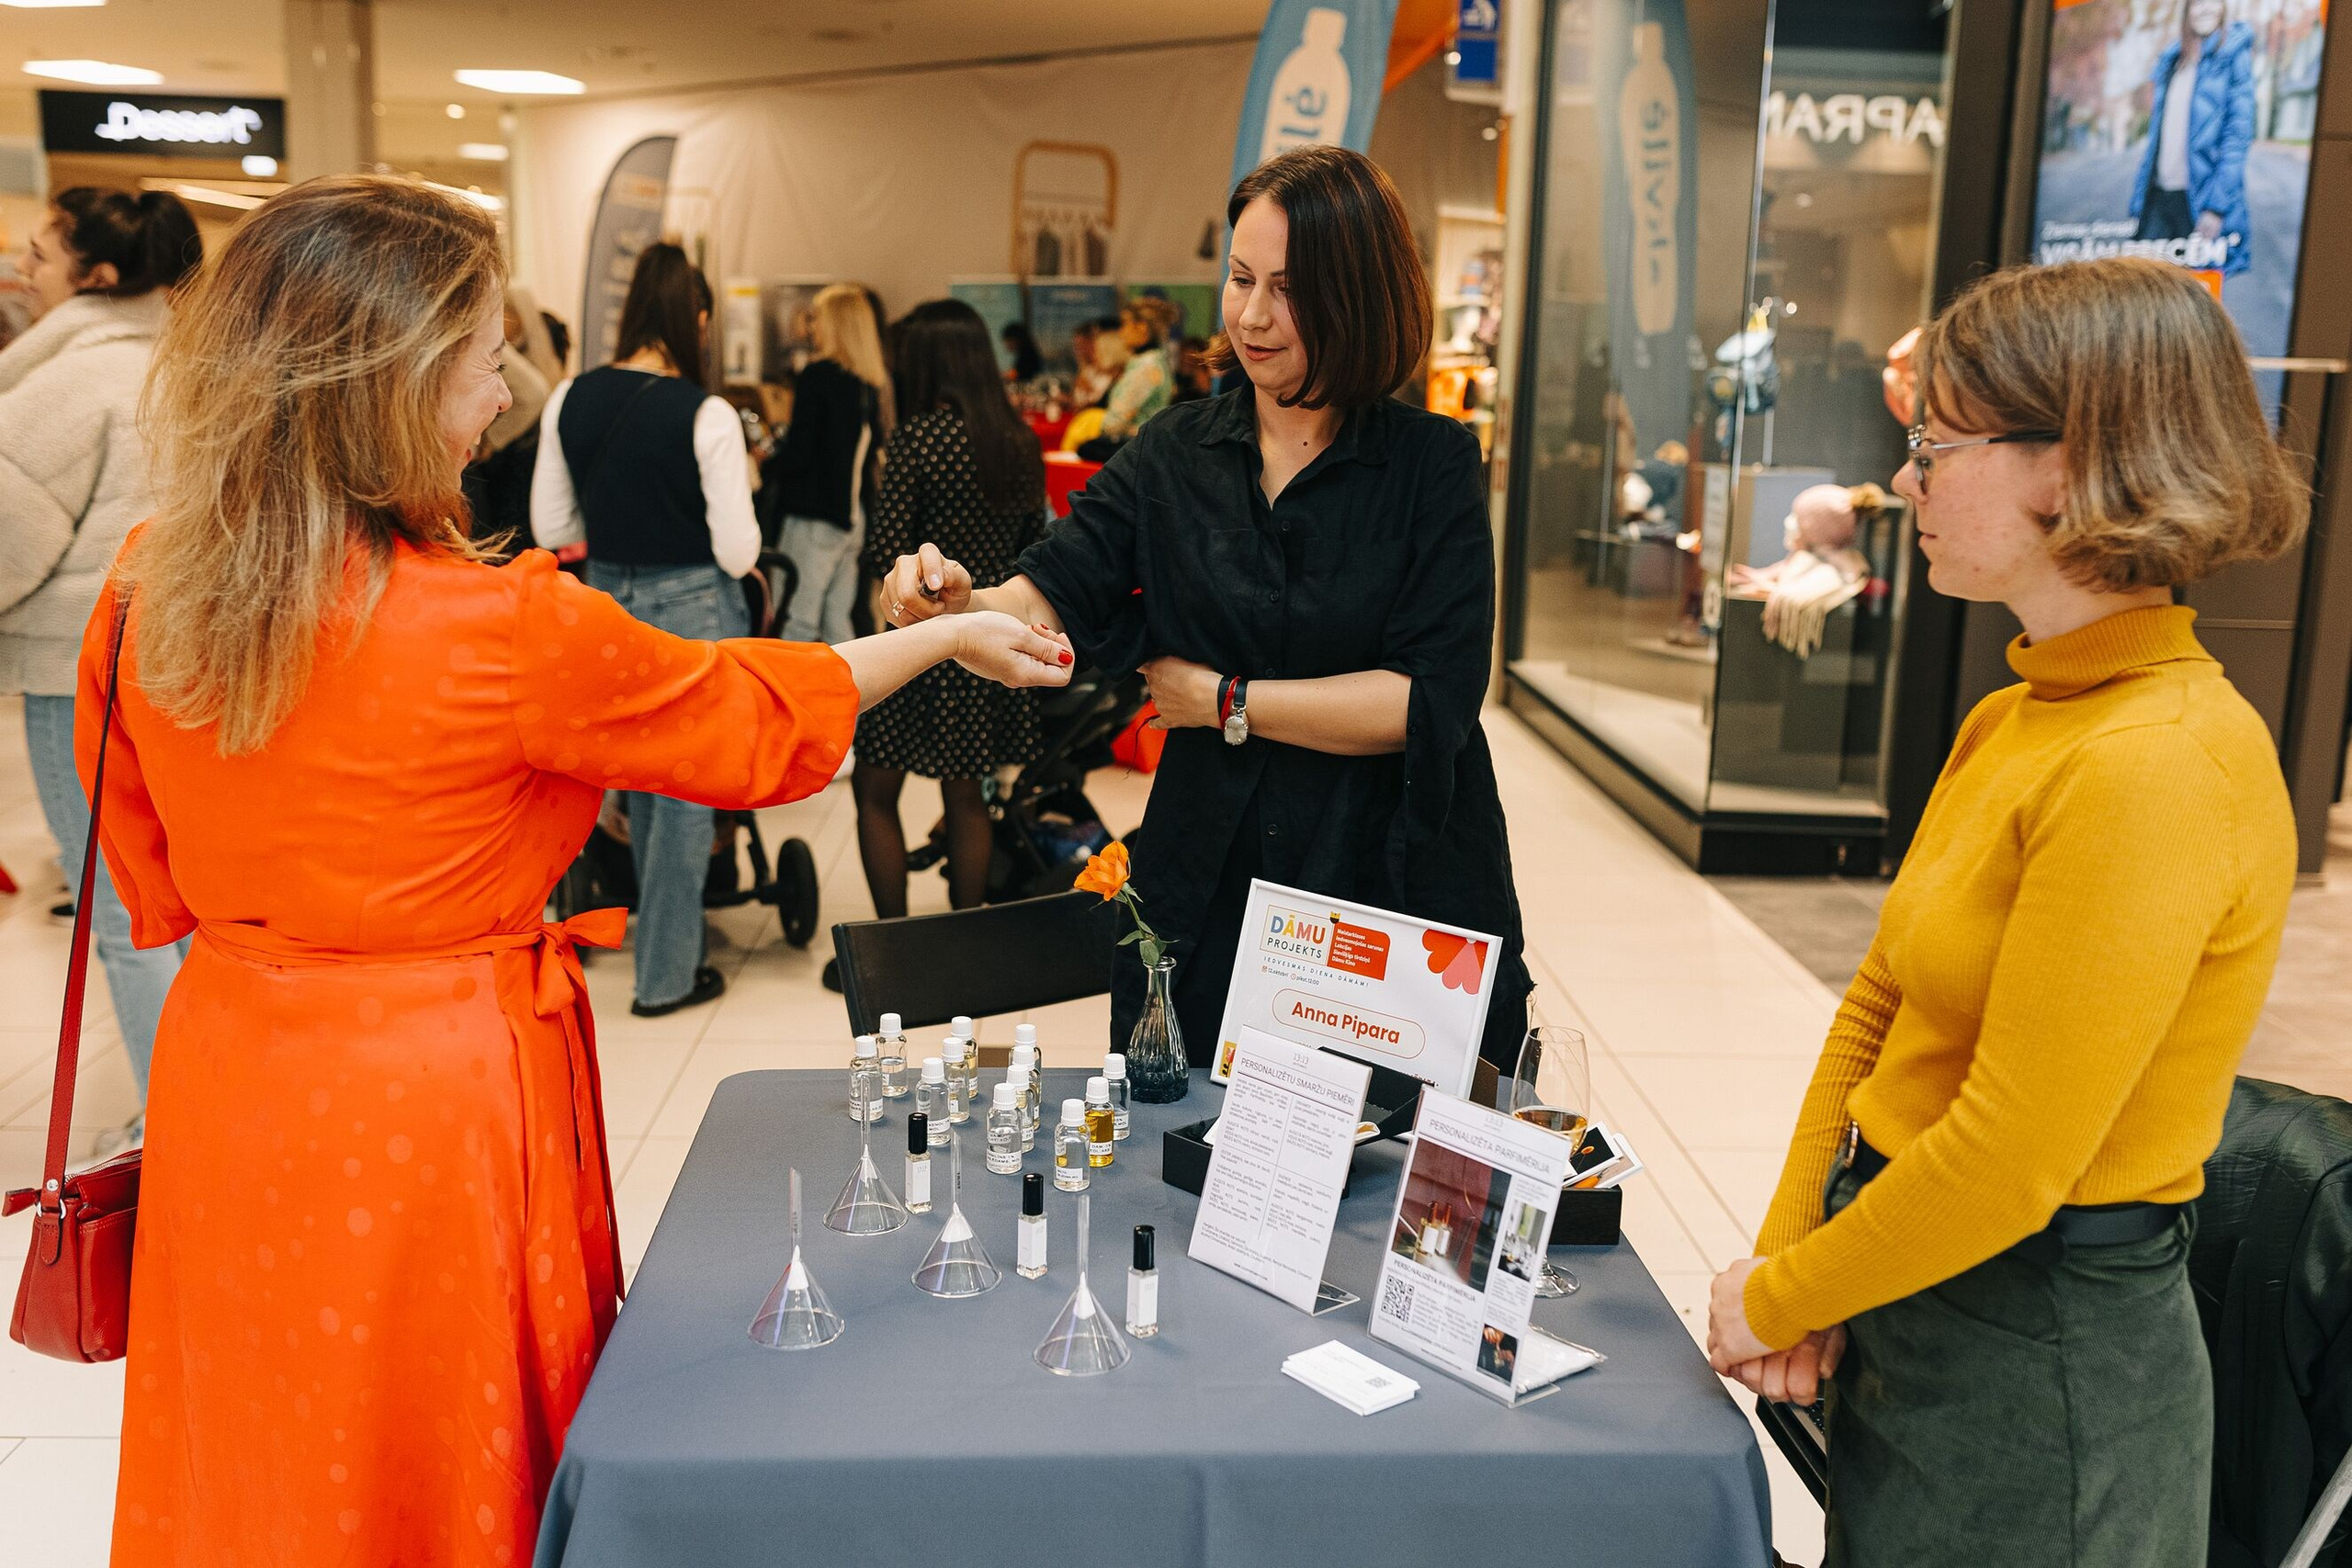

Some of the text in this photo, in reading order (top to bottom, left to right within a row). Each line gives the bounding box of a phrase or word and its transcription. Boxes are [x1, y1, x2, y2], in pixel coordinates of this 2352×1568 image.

[1271, 914, 1326, 944] DĀMU
[1267, 937, 1322, 959] PROJEKTS
[1264, 956, 1306, 972] IEDVESMAS
[1310, 968, 1333, 978] DIENA
[1292, 1001, 1400, 1044] Anna Pipara
[1240, 1057, 1295, 1085] PERSONALIZĒTU
[1296, 1077, 1326, 1096] SMARŽU
[1327, 1089, 1355, 1107] PIEMĒRI
[1429, 1118, 1494, 1153] PERSONALIZĒTA
